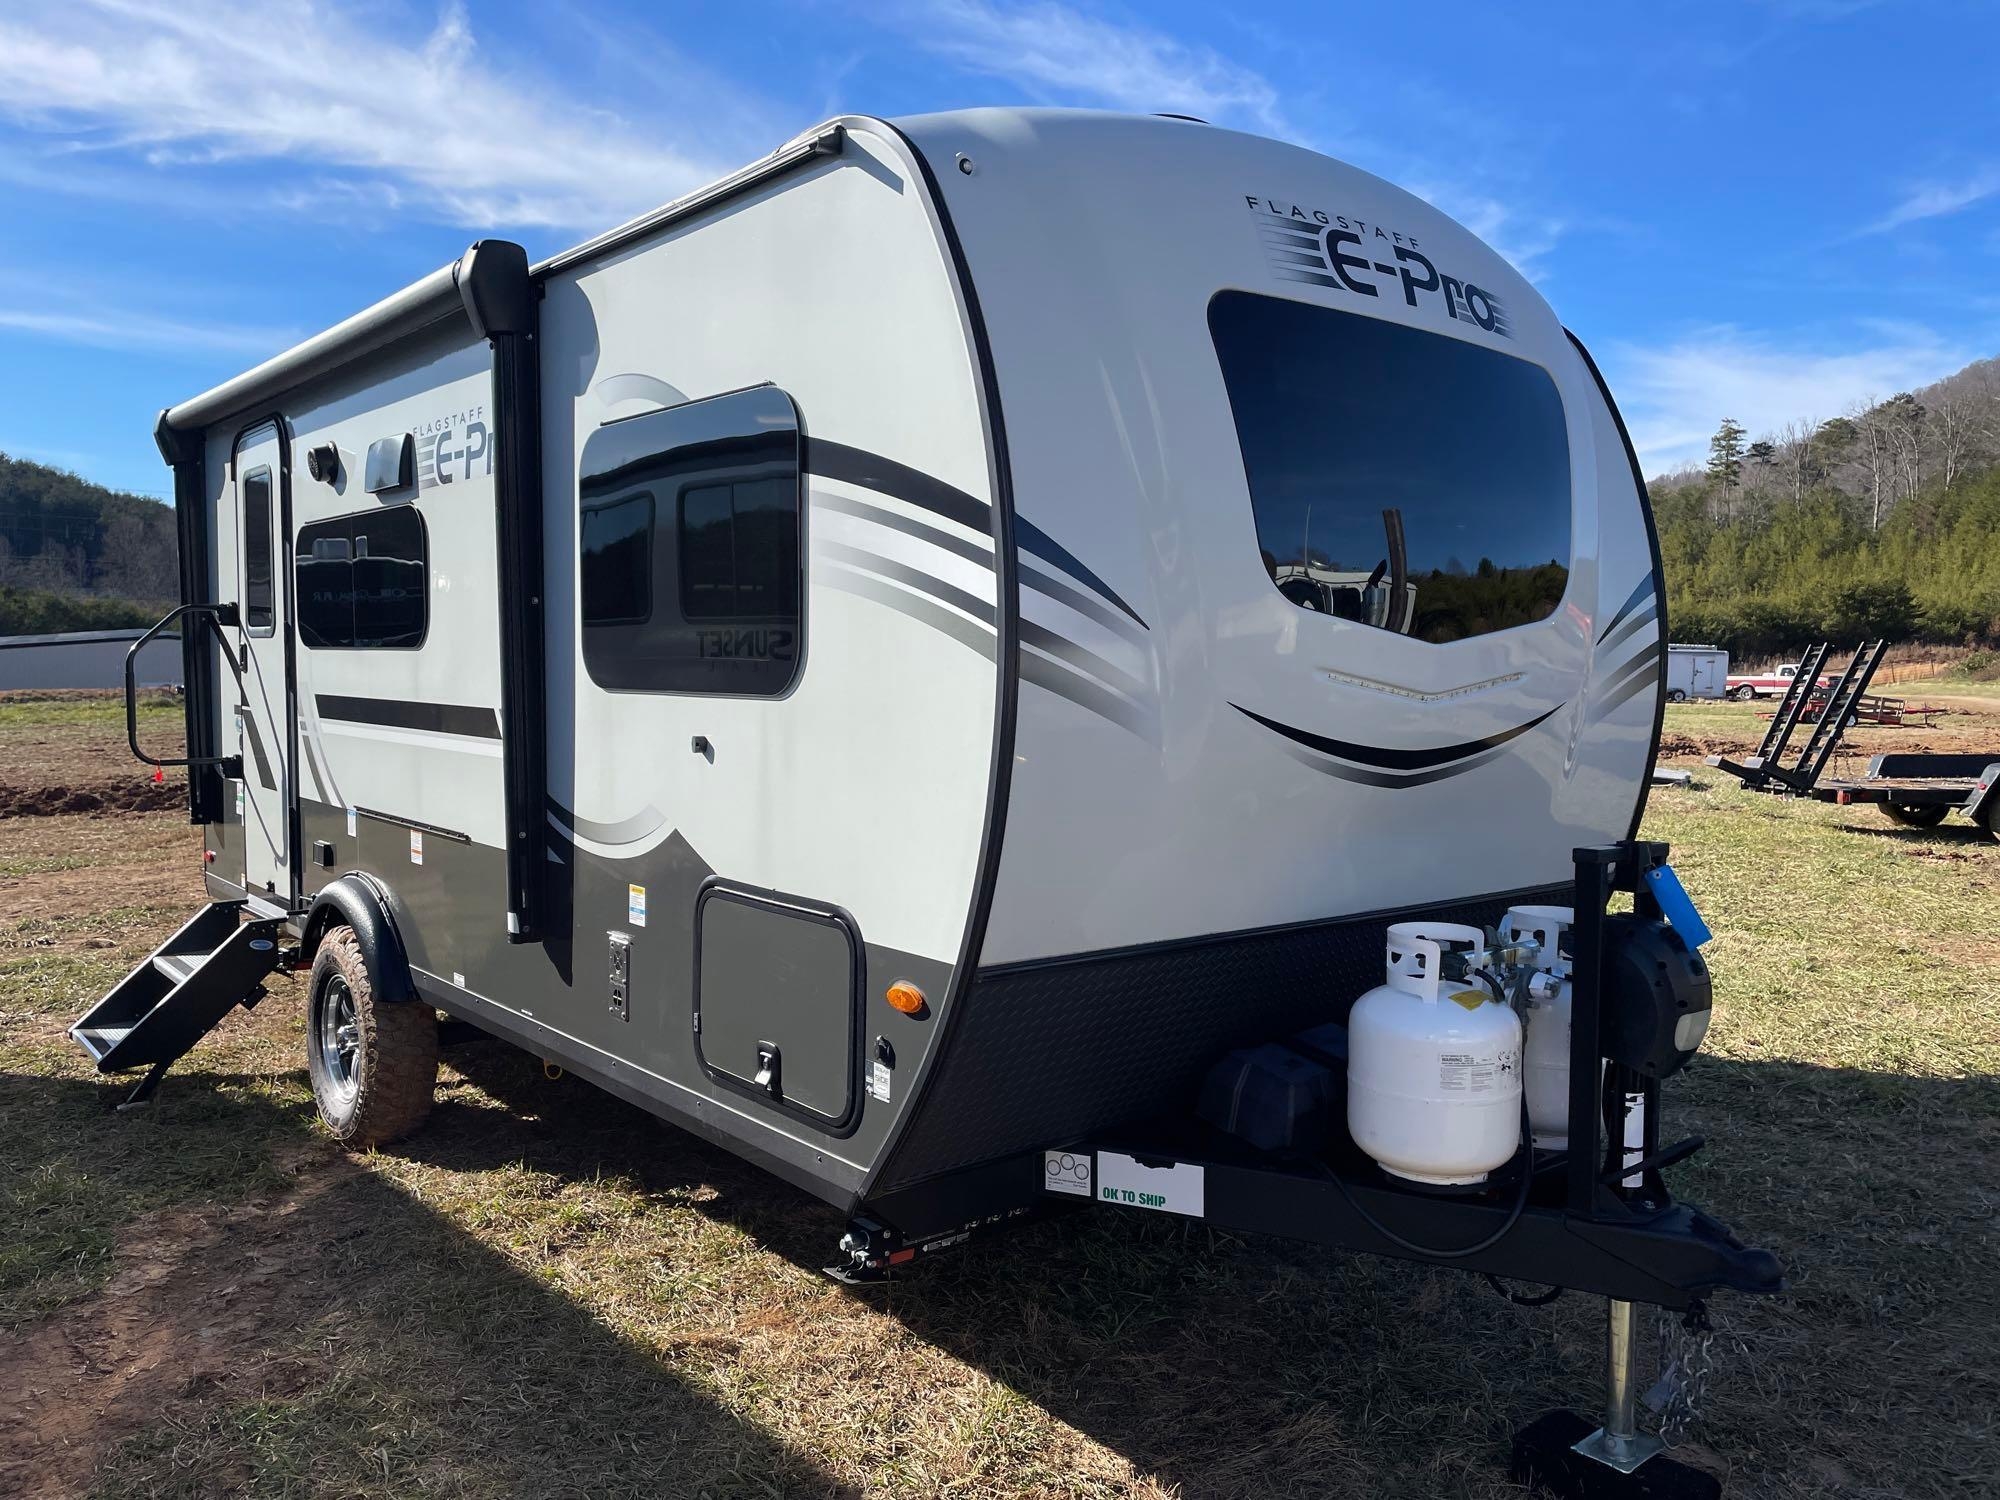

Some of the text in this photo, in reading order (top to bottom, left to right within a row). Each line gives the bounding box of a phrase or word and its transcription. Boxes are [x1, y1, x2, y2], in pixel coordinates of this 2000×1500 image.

[1245, 195, 1419, 249] FLAGSTAFF
[1325, 229, 1496, 332] E-Pro
[413, 406, 483, 437] FLAGSTAFF
[436, 421, 494, 485] E-Pr
[1102, 1186, 1167, 1208] OK TO SHIP
